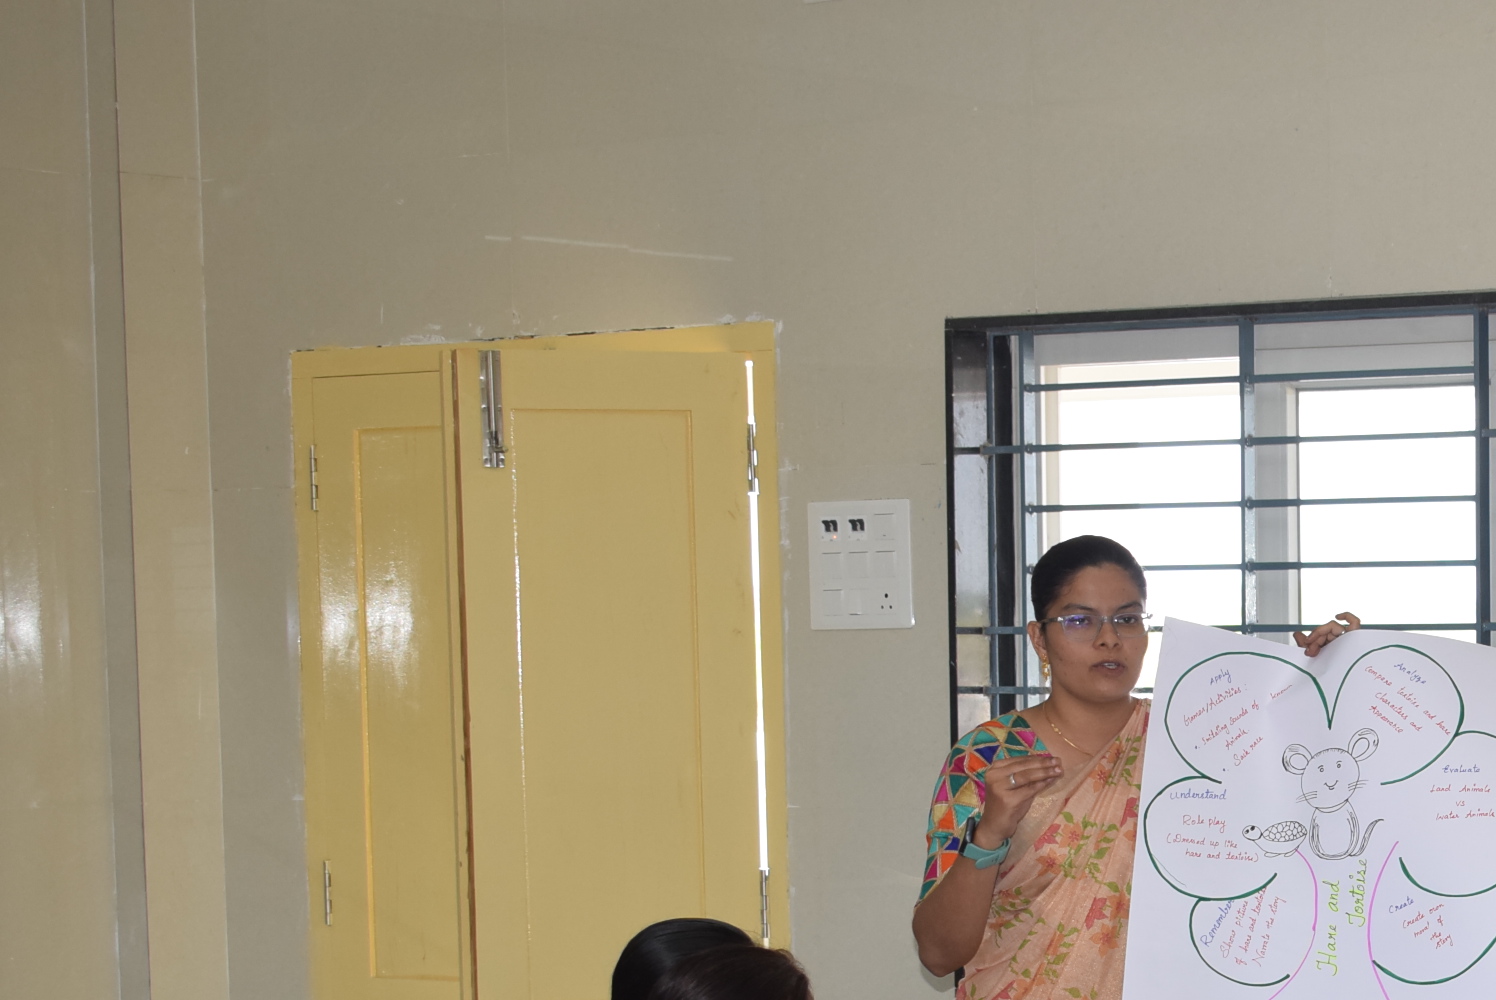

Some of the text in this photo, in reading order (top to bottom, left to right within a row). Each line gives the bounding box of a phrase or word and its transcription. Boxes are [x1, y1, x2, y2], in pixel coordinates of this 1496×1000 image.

[1251, 699, 1260, 711] of
[1423, 709, 1437, 721] and
[1409, 721, 1423, 732] and
[1441, 763, 1481, 774] Evaluate
[1429, 783, 1452, 793] Land
[1182, 814, 1227, 834] Role play
[1209, 839, 1220, 849] up
[1224, 839, 1238, 849] like
[1185, 848, 1202, 858] hare
[1206, 851, 1221, 859] and
[1345, 858, 1368, 928] Tortoise
[1388, 895, 1414, 914] Create
[1199, 899, 1235, 948] Remember
[1248, 916, 1257, 932] and
[1402, 910, 1426, 929] Create
[1436, 914, 1444, 927] of
[1315, 880, 1340, 977] Hare and
